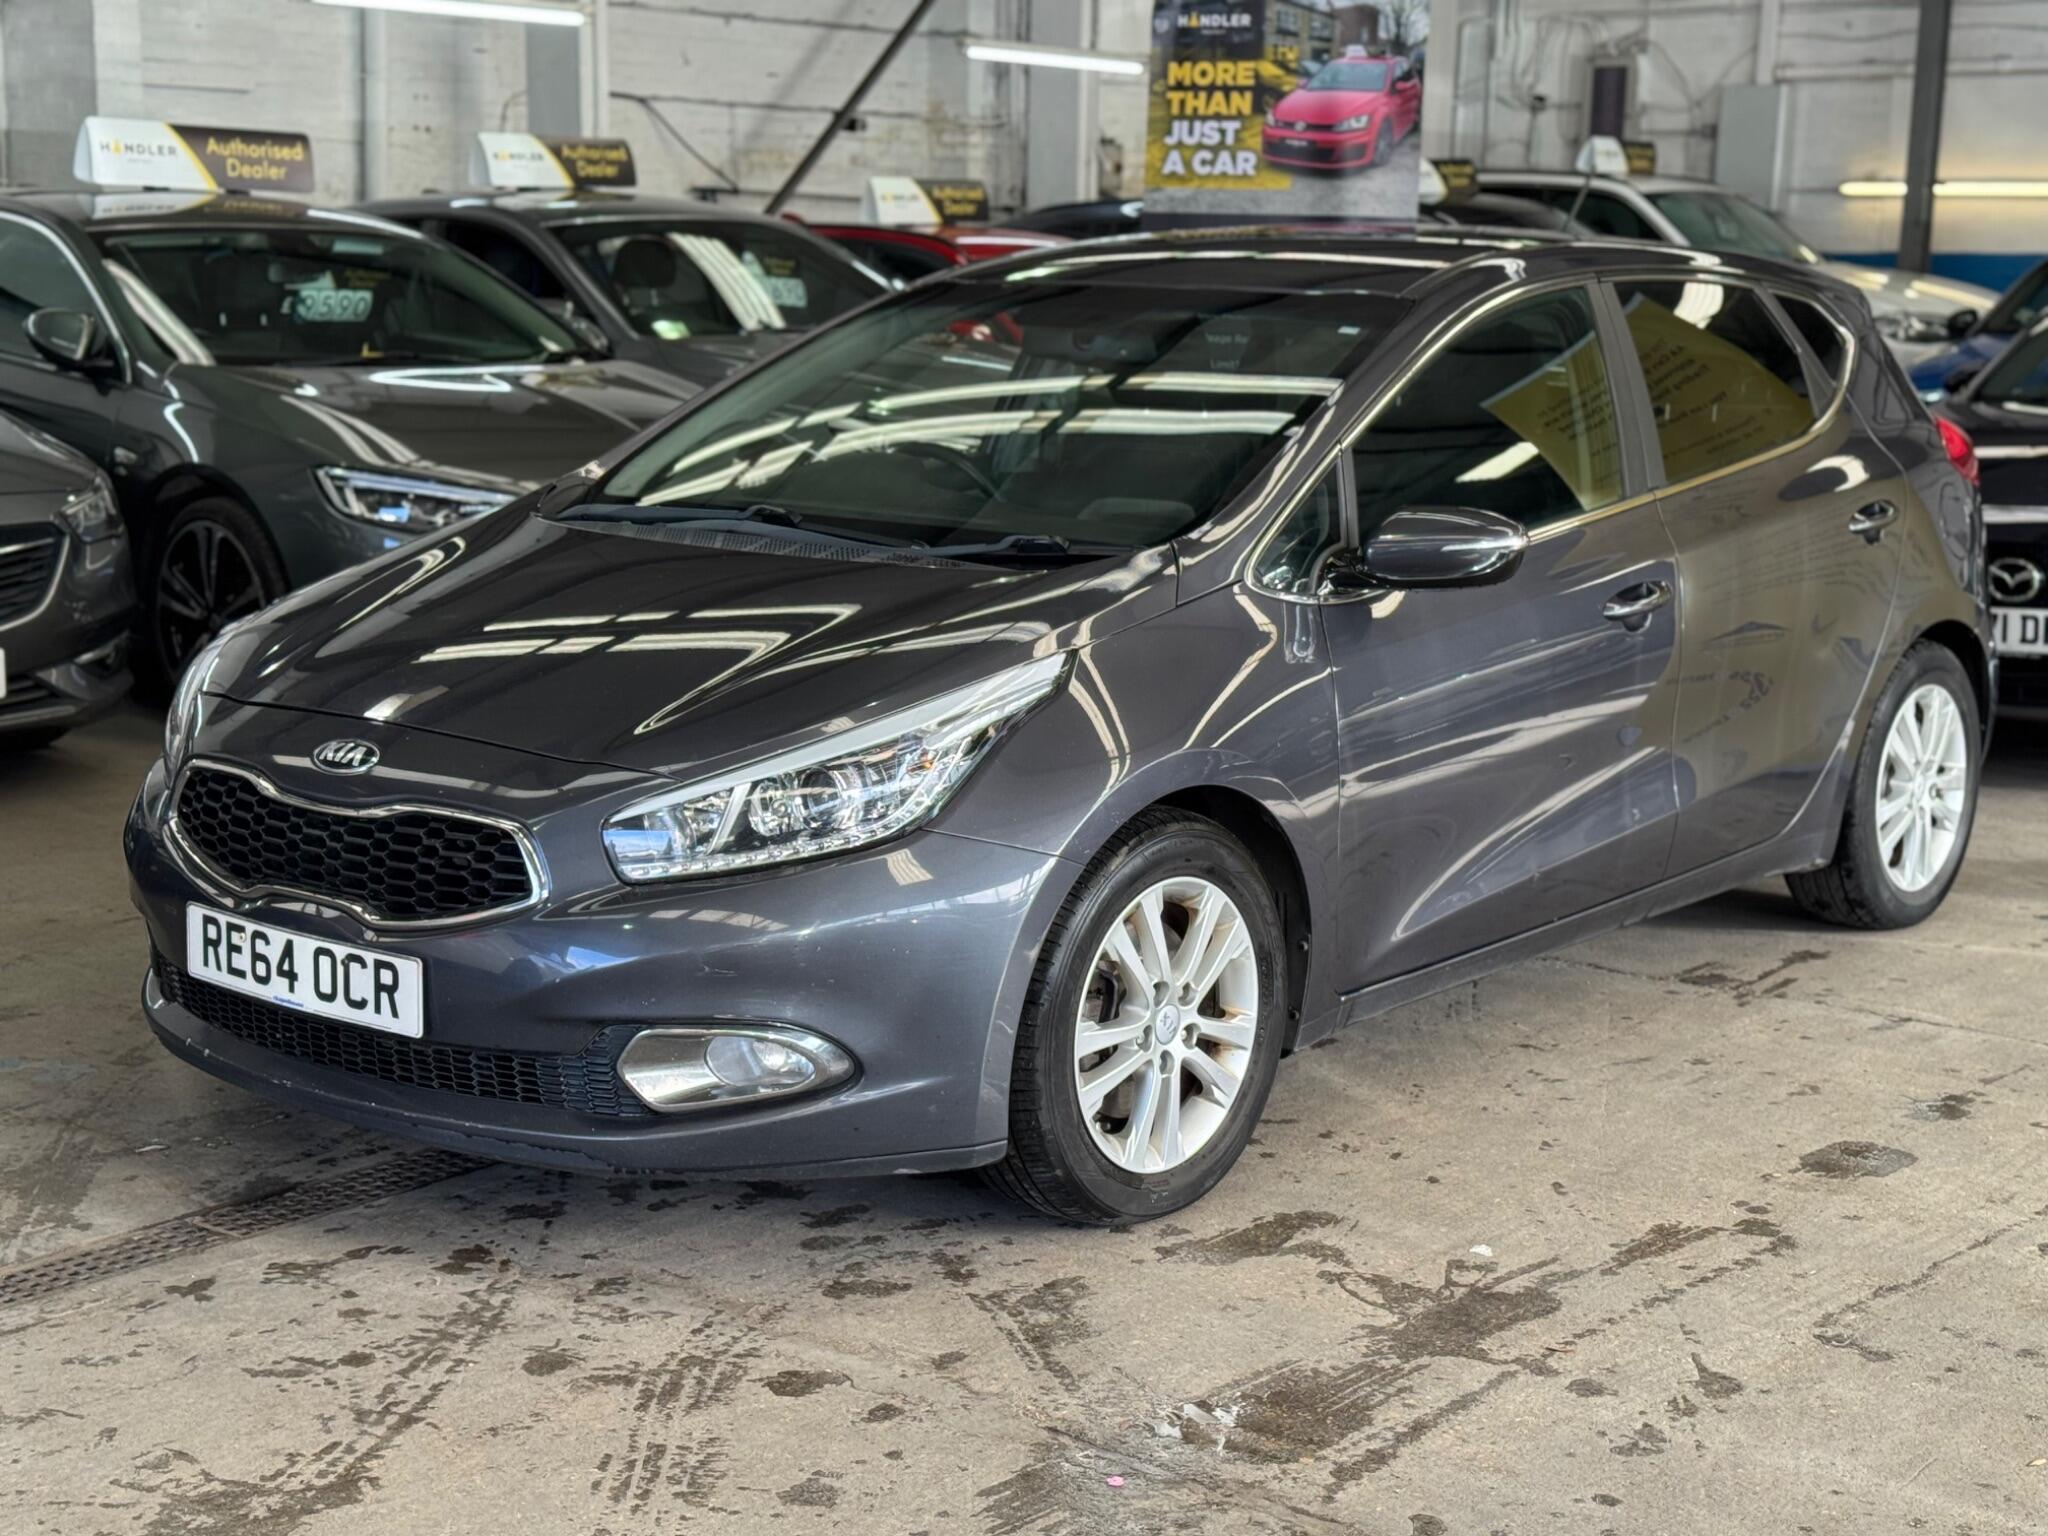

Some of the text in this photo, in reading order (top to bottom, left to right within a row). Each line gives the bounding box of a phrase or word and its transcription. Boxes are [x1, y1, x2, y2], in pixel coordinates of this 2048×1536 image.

[1167, 61, 1256, 86] MORE
[1166, 90, 1253, 116] THAN
[1163, 119, 1241, 146] JUST
[206, 136, 304, 161] Authorised
[225, 159, 287, 180] Dealer
[1162, 150, 1257, 176] A CAR
[318, 741, 368, 767] KIA
[202, 913, 400, 1019] RE64 OCR
